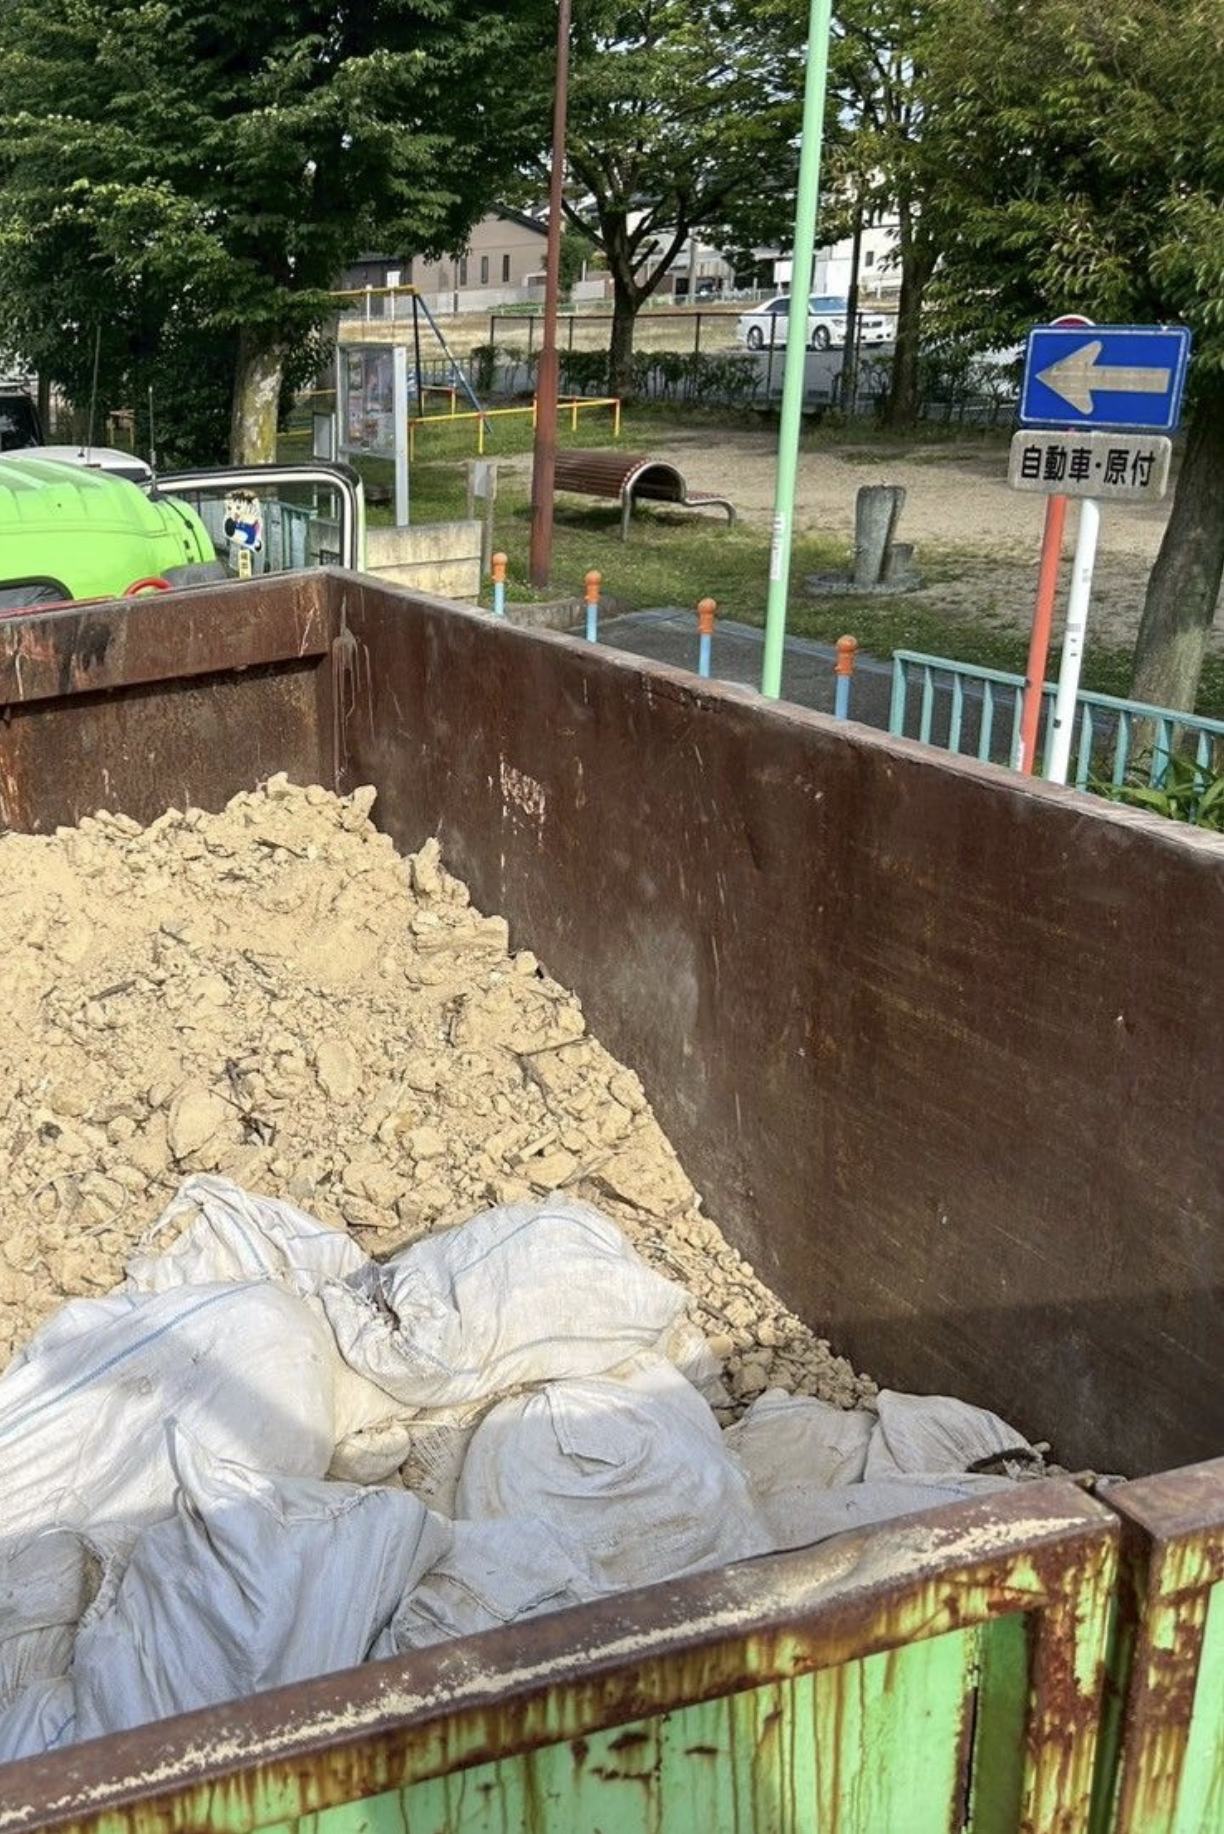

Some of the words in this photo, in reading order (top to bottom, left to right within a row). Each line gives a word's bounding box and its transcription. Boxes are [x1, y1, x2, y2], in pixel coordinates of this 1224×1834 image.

[1021, 444, 1155, 487] 自動車・原付
